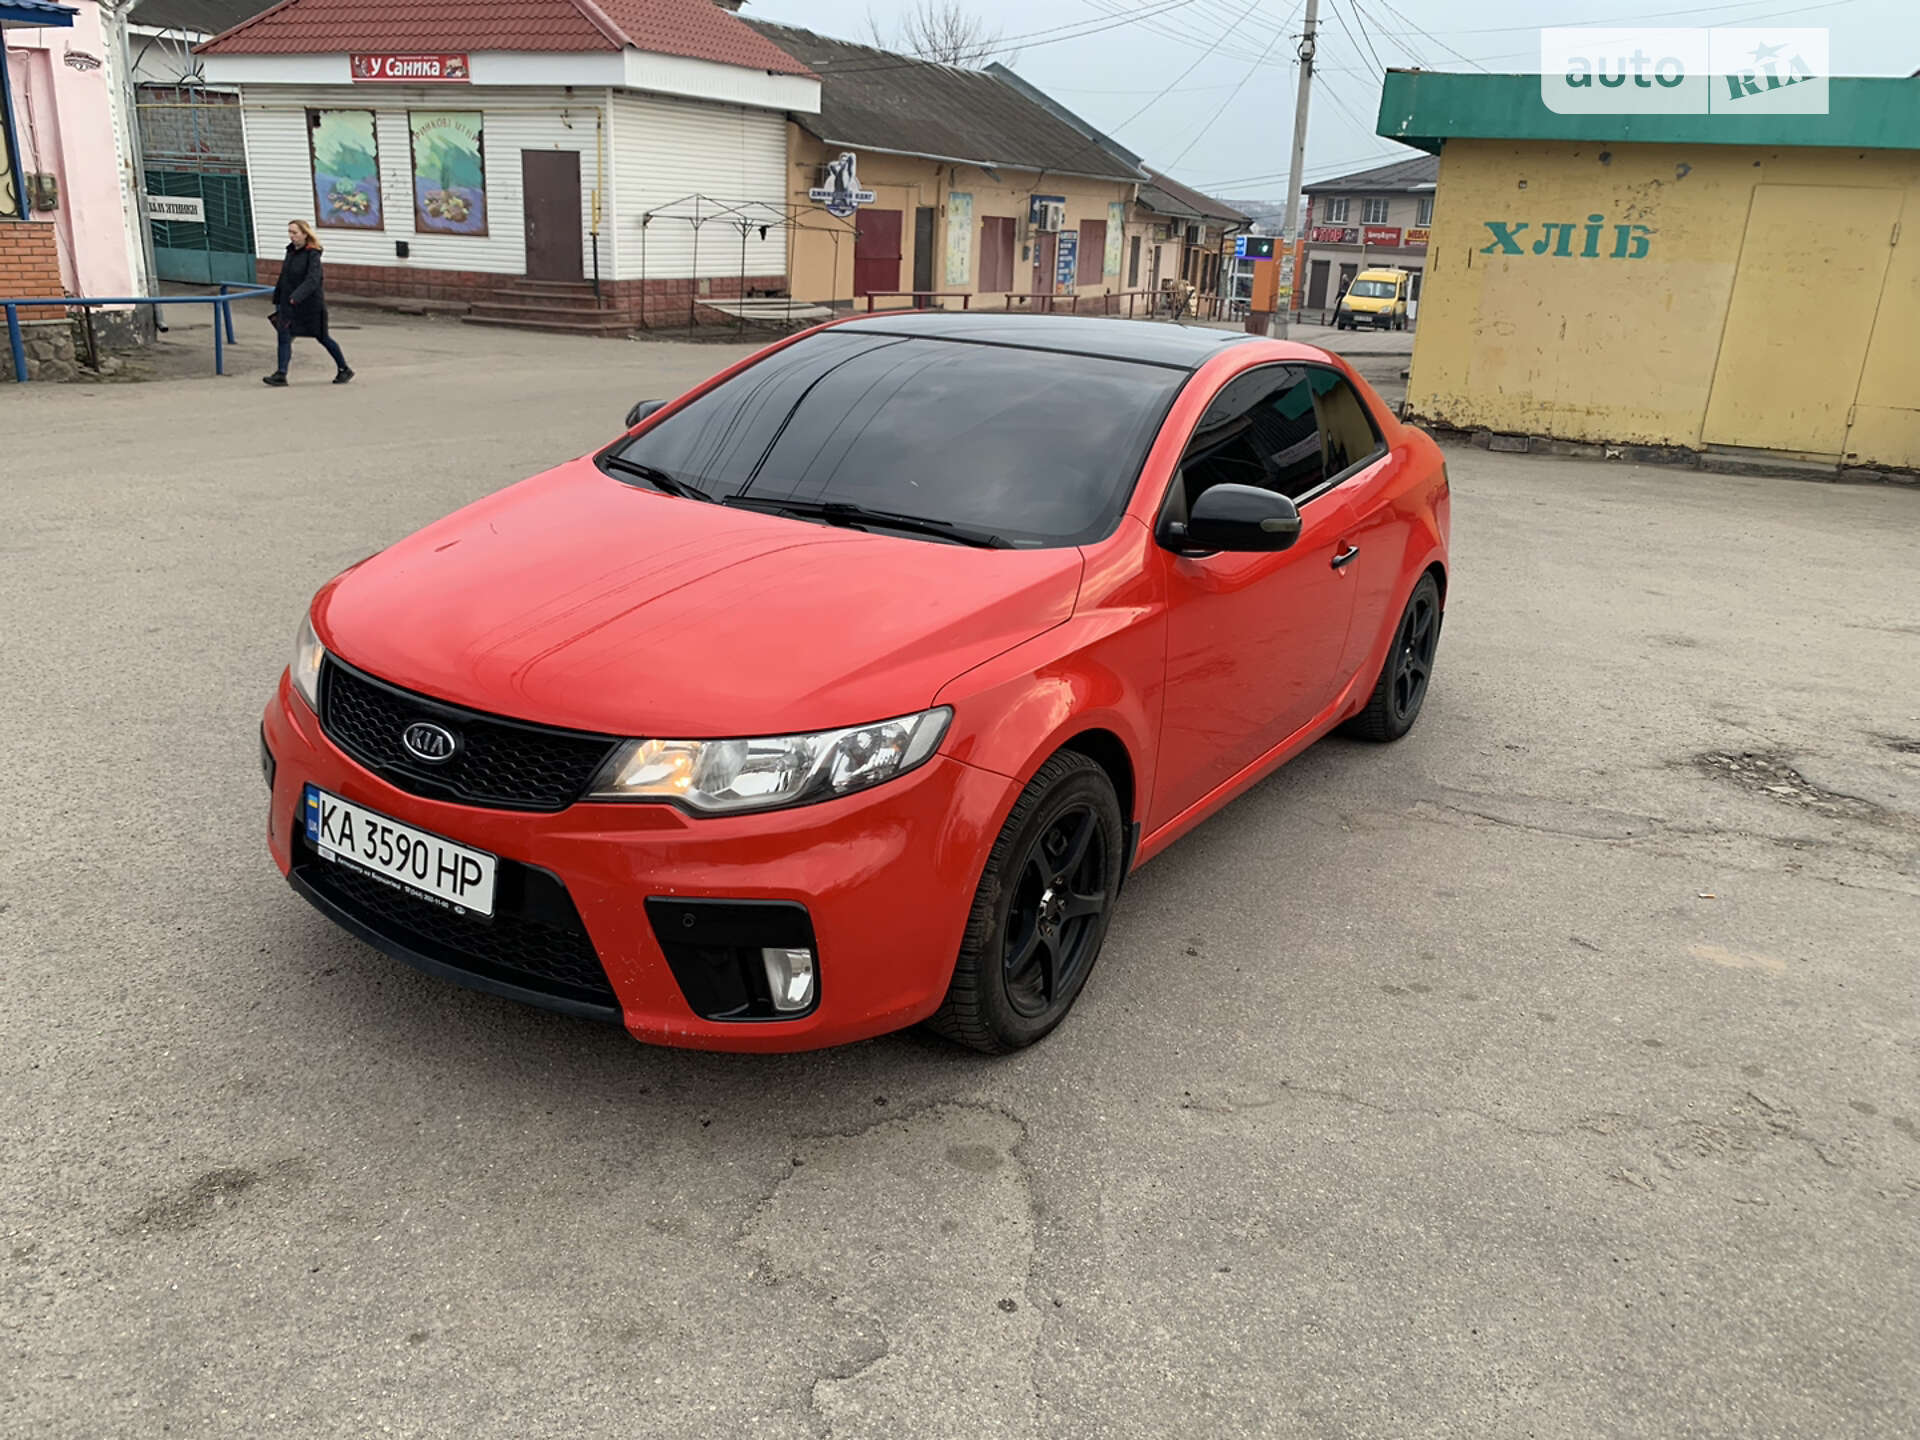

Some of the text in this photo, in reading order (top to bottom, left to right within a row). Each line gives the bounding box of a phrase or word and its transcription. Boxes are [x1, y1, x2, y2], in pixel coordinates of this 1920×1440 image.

[370, 58, 440, 76] У Саника
[411, 728, 444, 755] KIA
[321, 799, 355, 852] KA
[363, 819, 429, 880] 3590
[436, 847, 482, 897] HP
